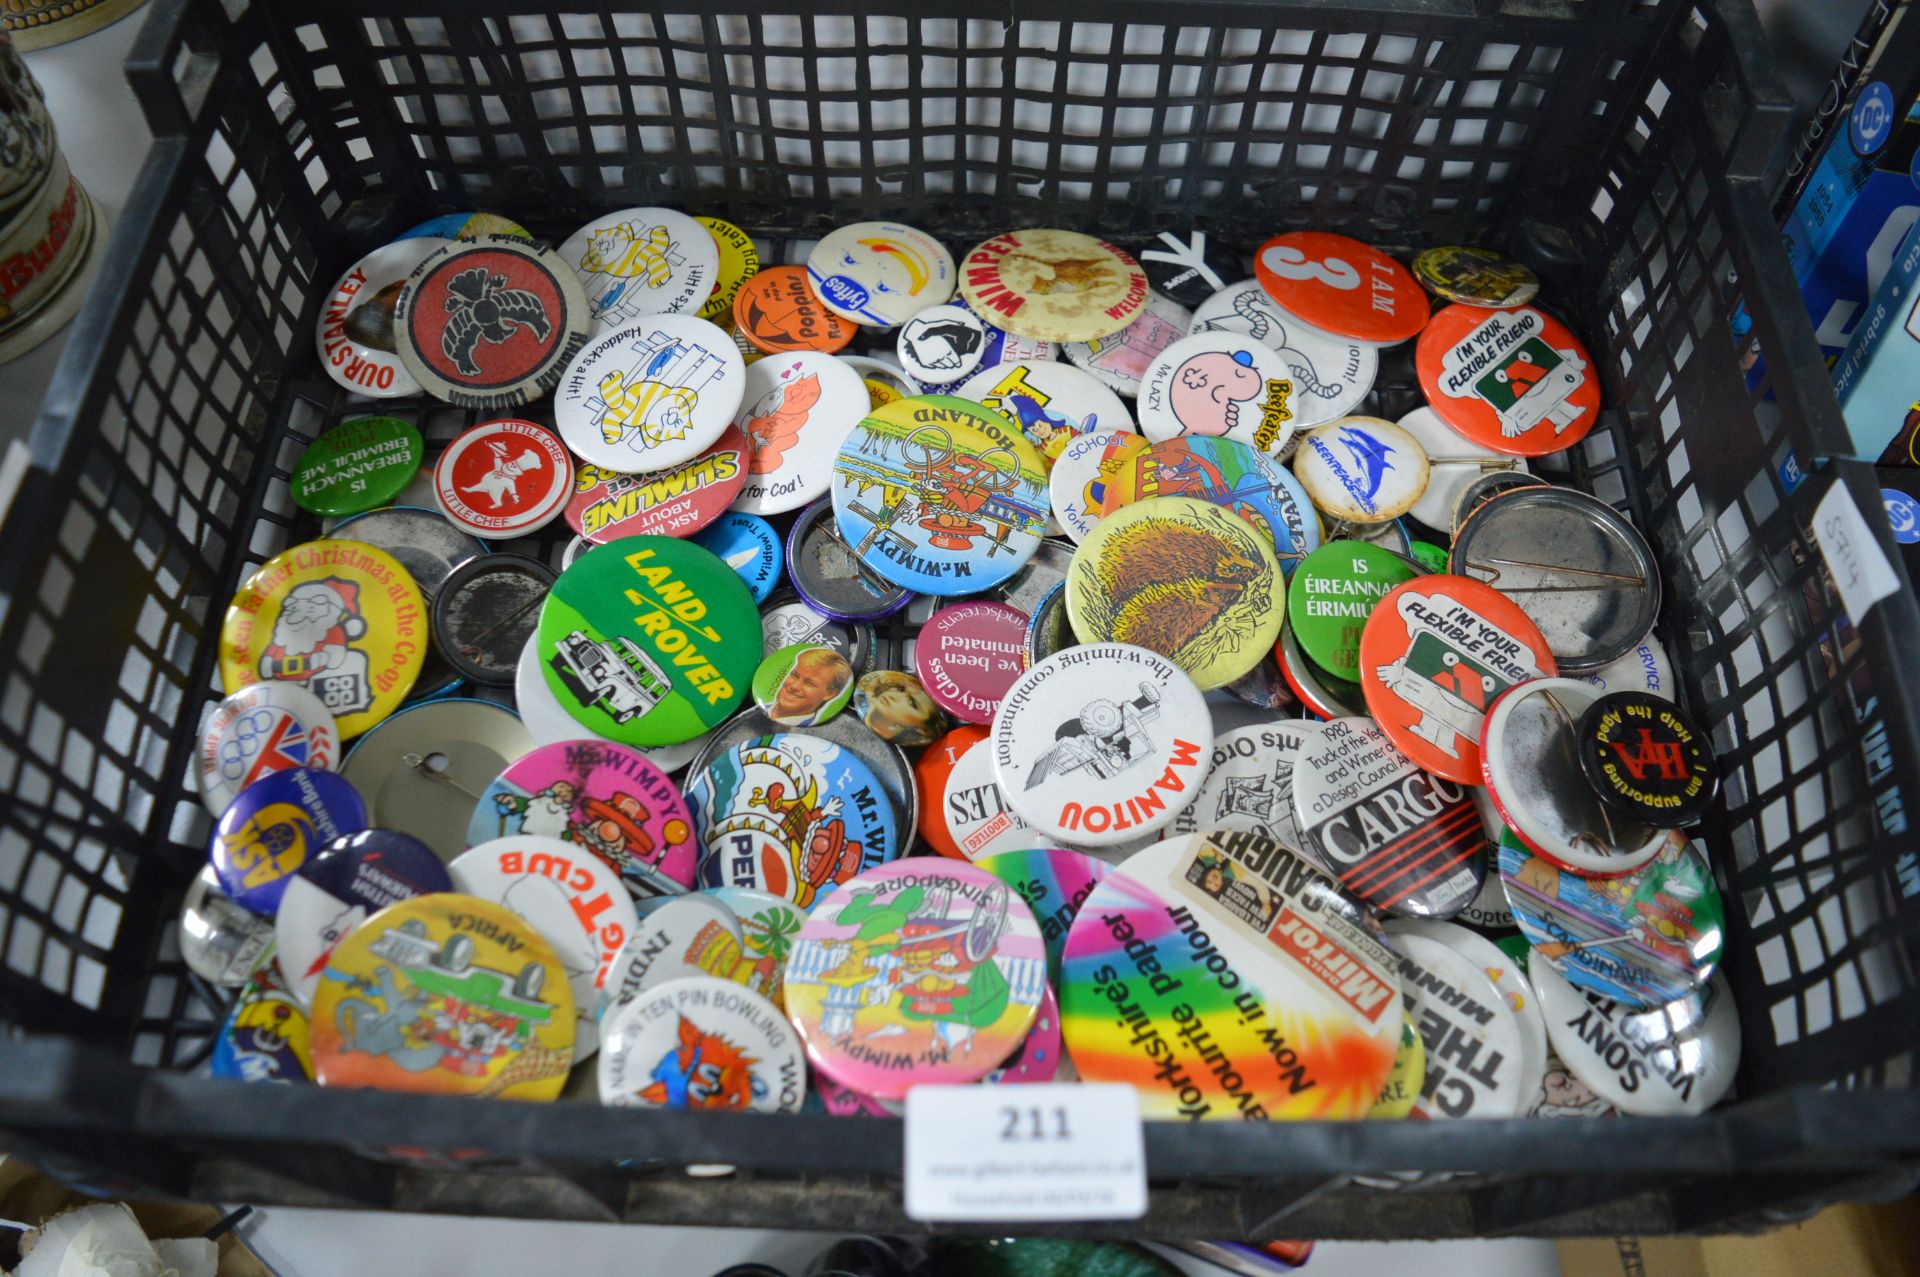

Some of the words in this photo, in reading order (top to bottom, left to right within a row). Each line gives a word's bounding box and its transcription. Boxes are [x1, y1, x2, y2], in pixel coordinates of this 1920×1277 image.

[1862, 105, 1882, 130] DC
[709, 219, 744, 249] Eater
[689, 264, 706, 286] Hit!
[732, 248, 758, 293] Happy
[967, 233, 1027, 318] WIMPEY
[1164, 269, 1199, 290] EUROPE
[1372, 261, 1394, 273] I
[704, 296, 728, 314] I'm
[726, 292, 735, 302] a
[786, 274, 818, 338] poppins
[826, 277, 867, 310] Fyffes
[1105, 272, 1145, 321] WELCOME
[1371, 277, 1395, 316] AM
[322, 266, 368, 361] STANLEY
[583, 326, 641, 371] Haddock's
[1448, 344, 1500, 393] FLEXIBLE
[1496, 315, 1536, 356] FRIEND
[1455, 345, 1476, 368] I'M
[1470, 318, 1503, 351] YOUR
[1852, 304, 1886, 368] gabriel
[342, 364, 396, 391] OUR
[565, 375, 586, 402] Hit!
[577, 366, 586, 376] a
[1157, 363, 1172, 384] Mr
[1149, 382, 1163, 412] LAZY
[1258, 378, 1293, 452] Beefeater
[502, 422, 534, 441] LITTLE
[533, 434, 566, 466] CHEF
[913, 408, 1016, 450] HOLLAND
[1067, 435, 1128, 462] SCHOOL
[330, 437, 409, 466] ÉIRIMIÚIL
[1307, 434, 1357, 496] GREENPEACE
[300, 463, 325, 481] ME
[301, 450, 411, 495] ÉIREANNACH
[350, 478, 366, 492] IS
[747, 484, 767, 498] for
[770, 474, 804, 497] Cod!
[442, 489, 472, 521] LITTLE
[471, 512, 510, 528] CHEF
[582, 450, 738, 536] SLIMLINE
[641, 498, 692, 528] ABOUT
[668, 508, 698, 528] ASK
[731, 519, 759, 535] Trust
[297, 544, 397, 585] Christmas
[755, 530, 774, 582] Wildfowl
[1352, 559, 1369, 574] IS
[246, 564, 293, 615] Father
[387, 580, 408, 606] at
[624, 549, 708, 622] LAND
[395, 604, 418, 638] the
[1404, 601, 1482, 654] FLEXIBLE
[1446, 605, 1469, 626] I'M
[1476, 621, 1521, 661] YOUR
[233, 624, 254, 665] seen
[634, 613, 735, 707] ROVER
[944, 652, 991, 672] been
[1058, 647, 1141, 671] winning
[929, 656, 962, 700] Glass
[999, 664, 1055, 770] combination'
[1597, 709, 1622, 743] Aged
[1626, 704, 1652, 719] the
[1660, 712, 1693, 743] Help
[1320, 721, 1352, 742] 1982
[1306, 752, 1338, 771] Truck
[1350, 736, 1366, 753] the
[1326, 767, 1345, 786] and
[1342, 746, 1388, 778] Winner
[604, 749, 681, 818] WIMPY
[1058, 738, 1202, 833] MANITOU
[1313, 802, 1323, 814] a
[1321, 784, 1362, 810] Design
[1358, 762, 1401, 790] Council
[1603, 764, 1682, 808] supporting
[1685, 777, 1704, 797] am
[967, 816, 1009, 850] BOOTLEG
[1320, 770, 1466, 865] CARGO
[221, 821, 281, 890] ASK
[500, 851, 596, 890] CLUB
[875, 873, 993, 908] SINGAPORE
[447, 913, 525, 951] AFRICA
[1165, 906, 1240, 991] colour
[1102, 913, 1184, 997] paper
[1280, 917, 1390, 1012] Mirror
[1302, 955, 1341, 986] DAILY
[641, 997, 674, 1022] TEN
[678, 990, 709, 1005] PIN
[713, 990, 787, 1048] BOWLING
[1238, 992, 1265, 1026] in
[835, 1038, 915, 1070] WIMPY
[1092, 964, 1212, 1120] Yorkshire's
[1419, 1012, 1506, 1091] THE
[1568, 1010, 1648, 1094] SONY
[1256, 1028, 1317, 1096] Now
[1000, 1105, 1072, 1140] 211
